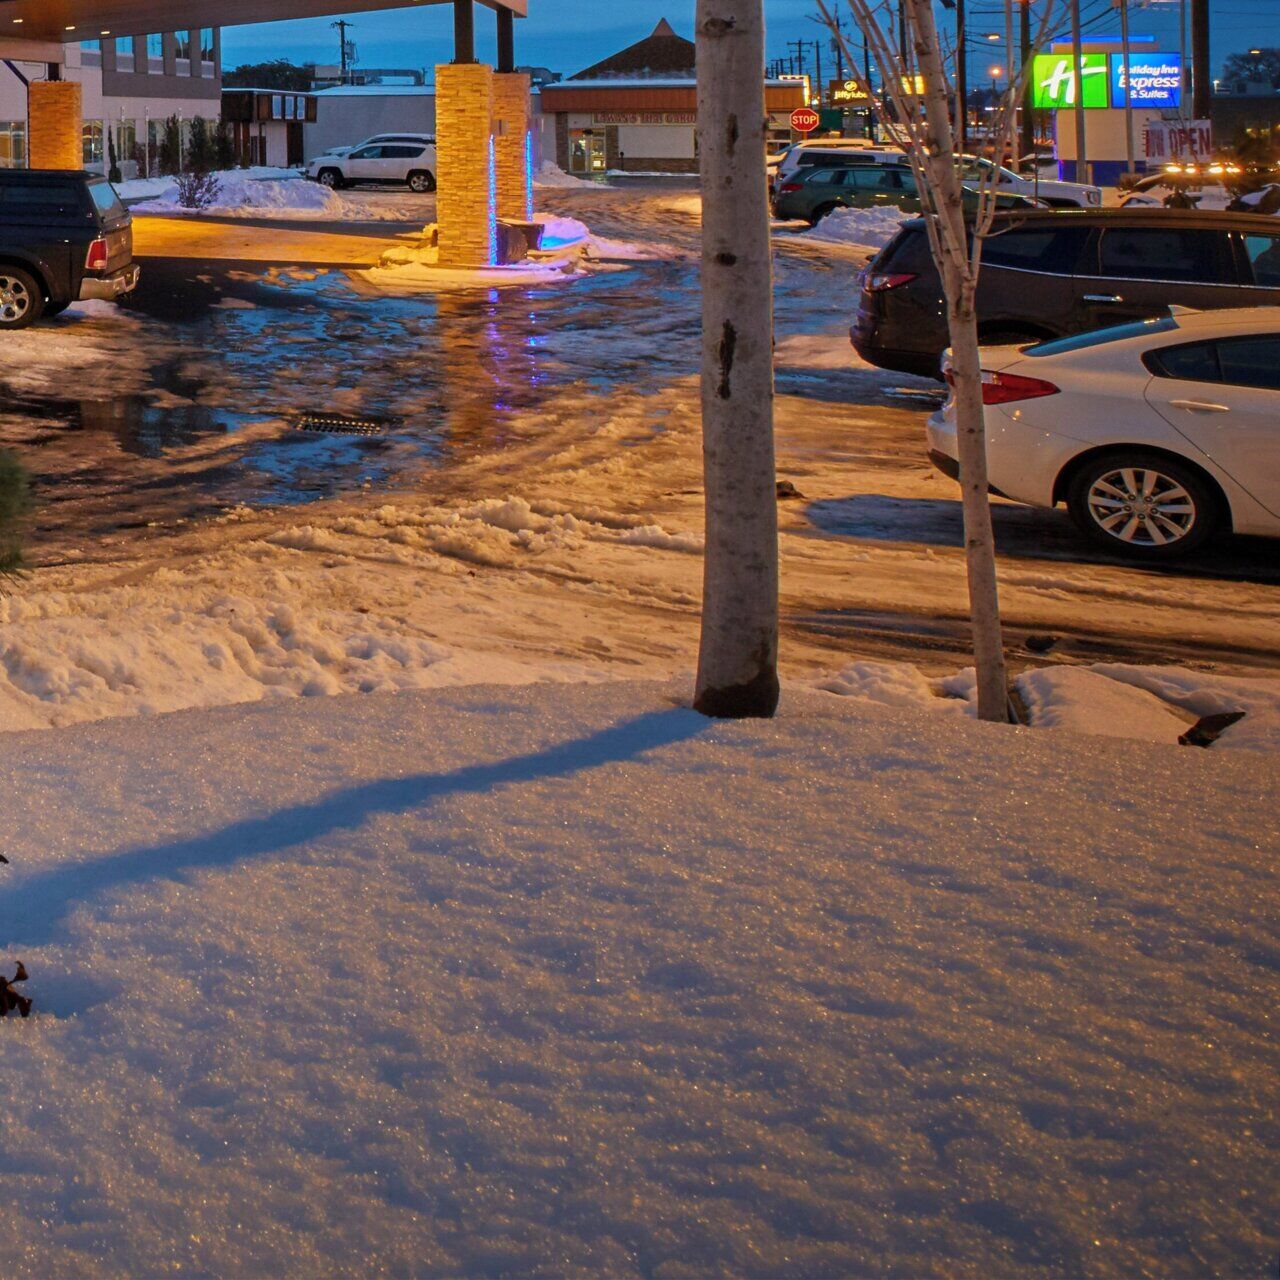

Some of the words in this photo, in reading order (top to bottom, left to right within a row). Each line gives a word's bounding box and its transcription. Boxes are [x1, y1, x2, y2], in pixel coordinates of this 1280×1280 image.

[1161, 64, 1179, 74] Inn
[1118, 75, 1181, 90] Express
[1138, 90, 1169, 98] Suites
[792, 115, 817, 125] STOP
[1168, 127, 1211, 156] OPEN
